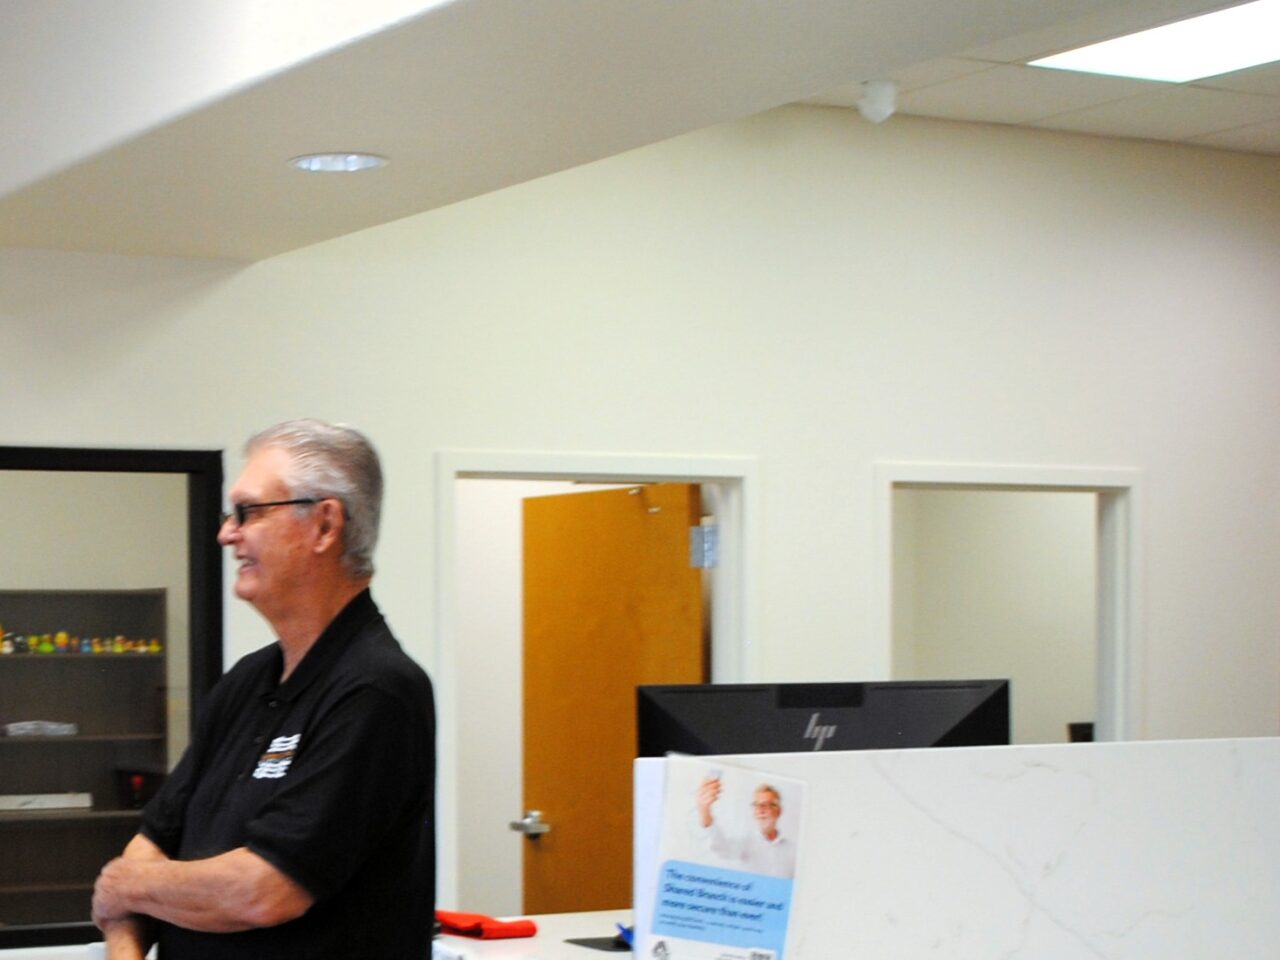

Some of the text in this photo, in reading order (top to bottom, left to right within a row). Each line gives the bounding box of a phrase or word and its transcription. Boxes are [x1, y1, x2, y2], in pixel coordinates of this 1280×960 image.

[803, 712, 838, 751] hp
[666, 868, 754, 891] The convenience of
[662, 899, 686, 909] more
[687, 903, 717, 914] secure
[719, 906, 738, 917] than
[664, 883, 695, 897] Shared
[696, 887, 727, 901] Branch
[766, 901, 784, 911] and
